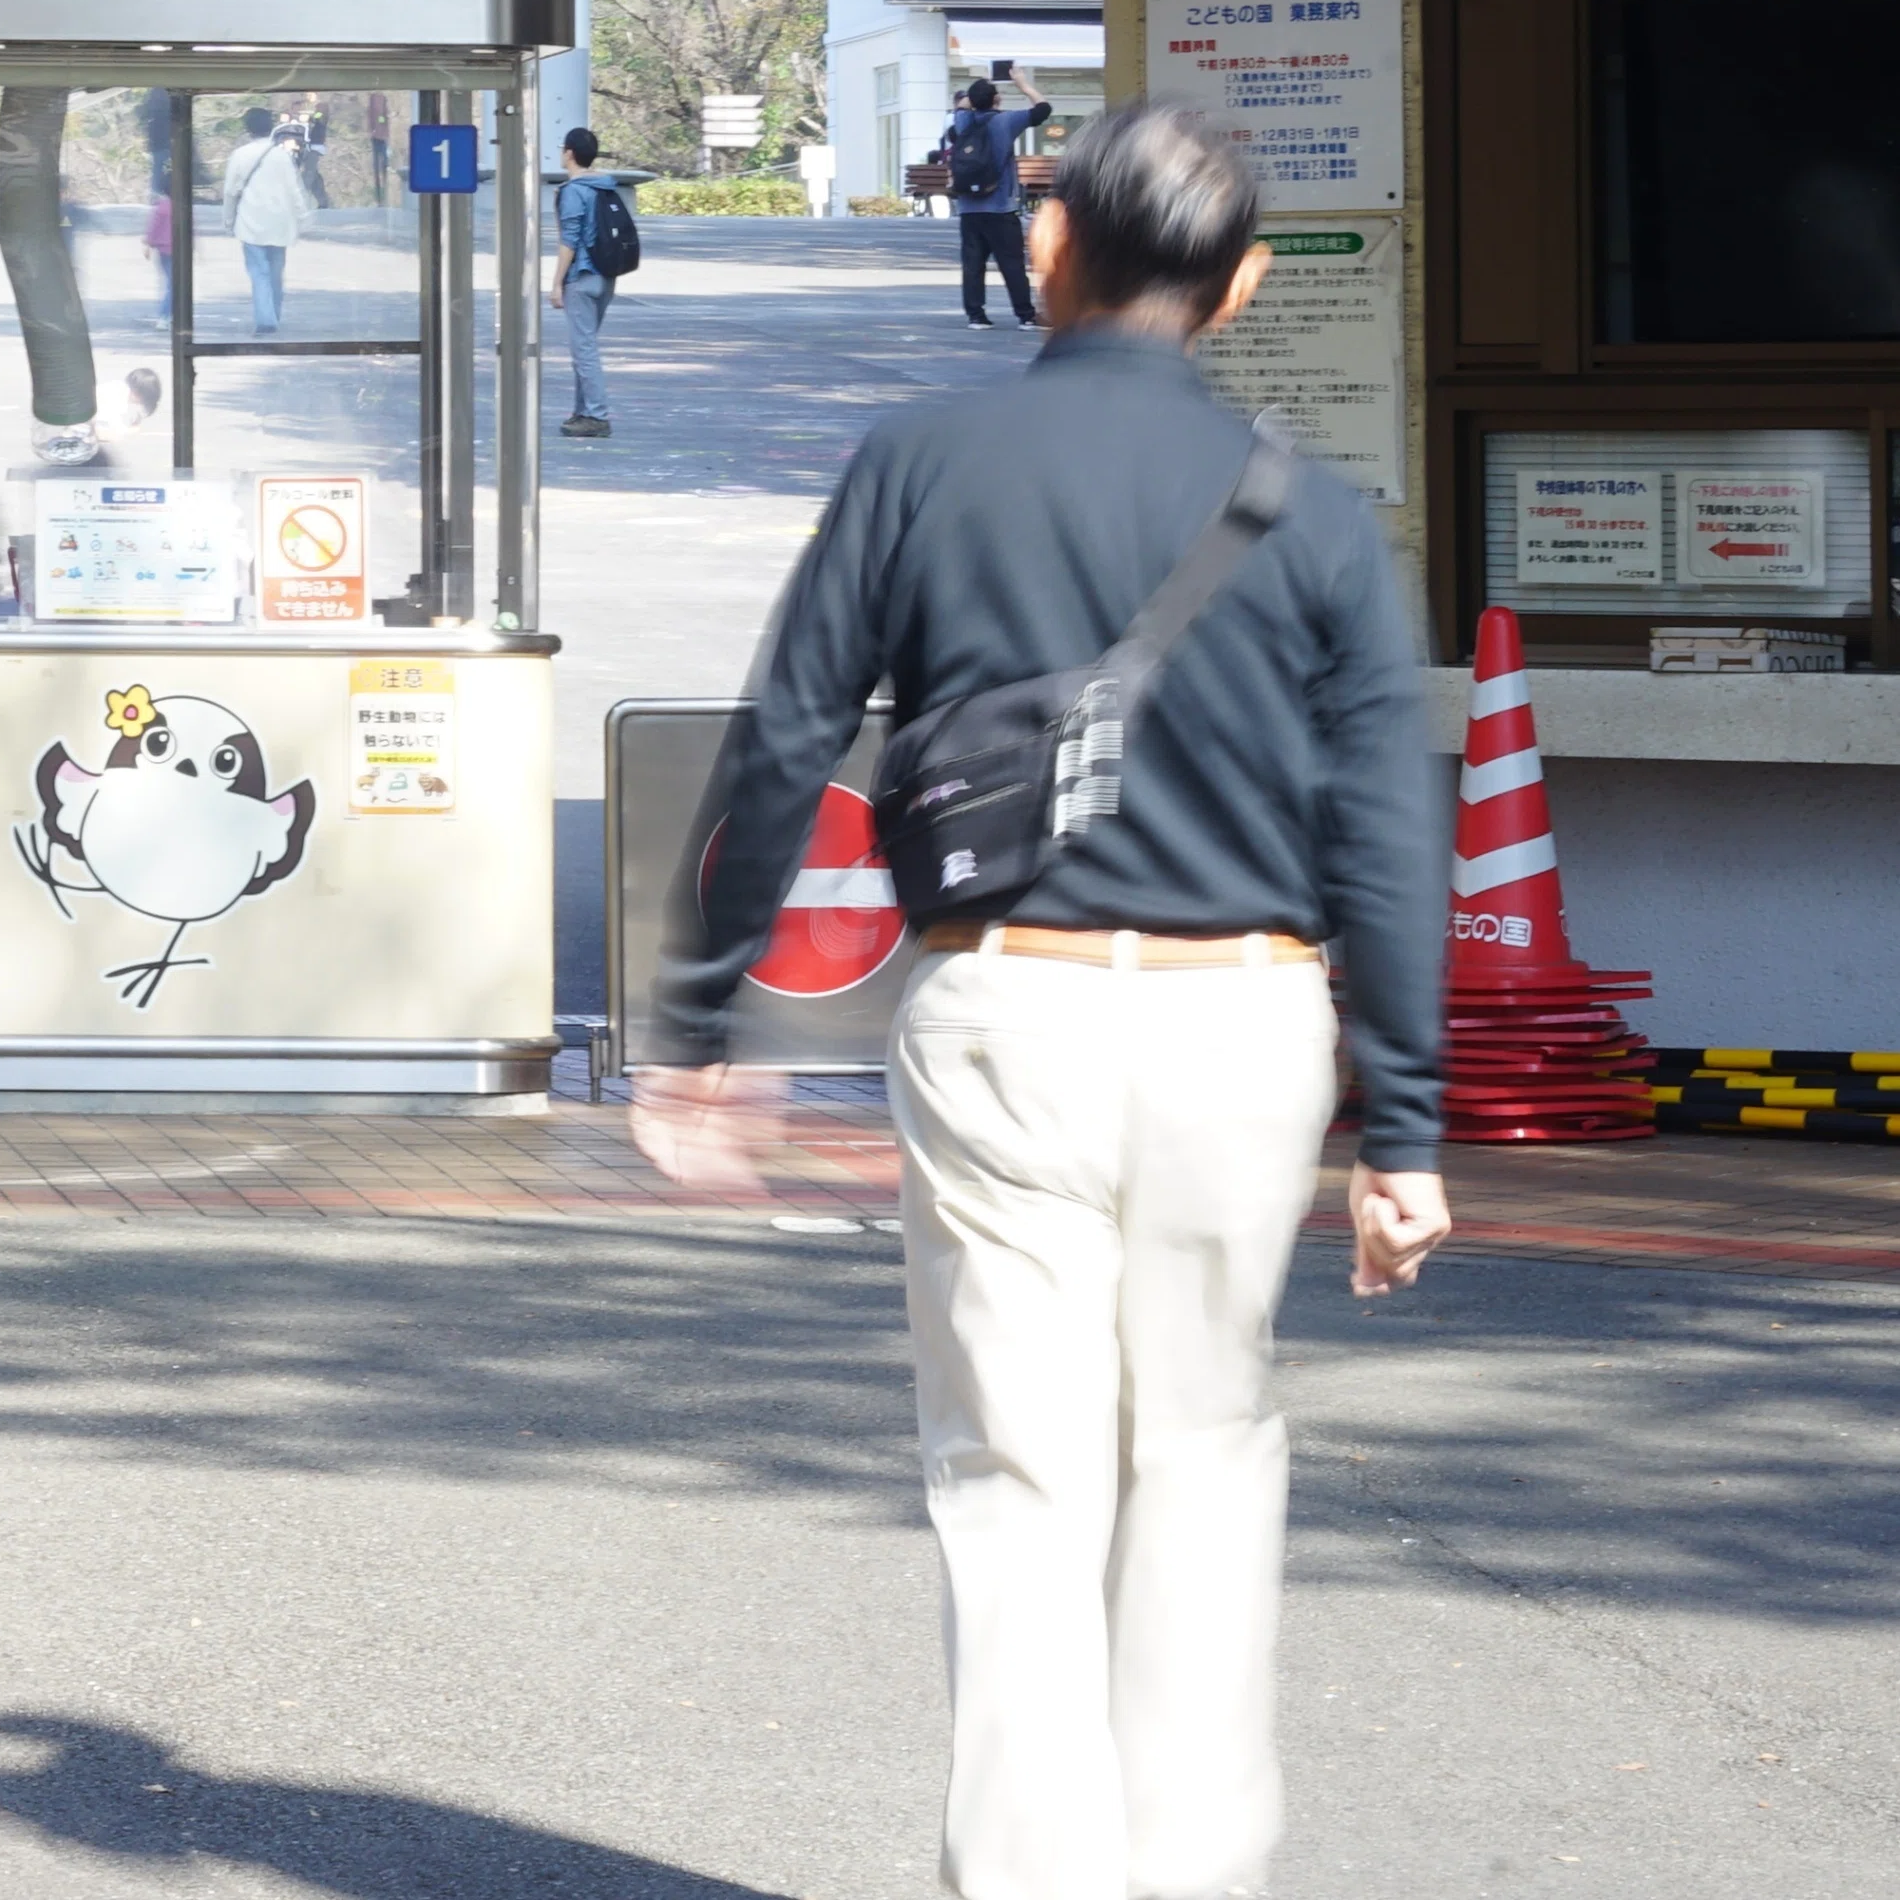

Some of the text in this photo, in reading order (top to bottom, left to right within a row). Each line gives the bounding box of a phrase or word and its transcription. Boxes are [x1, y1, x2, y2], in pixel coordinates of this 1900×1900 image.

[1186, 1, 1360, 26] こどもの国 業務案内
[430, 138, 454, 178] 1
[267, 489, 354, 500] アルコール飲料
[272, 600, 354, 618] できません
[380, 667, 424, 689] 注意
[358, 710, 447, 724] 野生動物には
[1446, 909, 1533, 949] もの国
